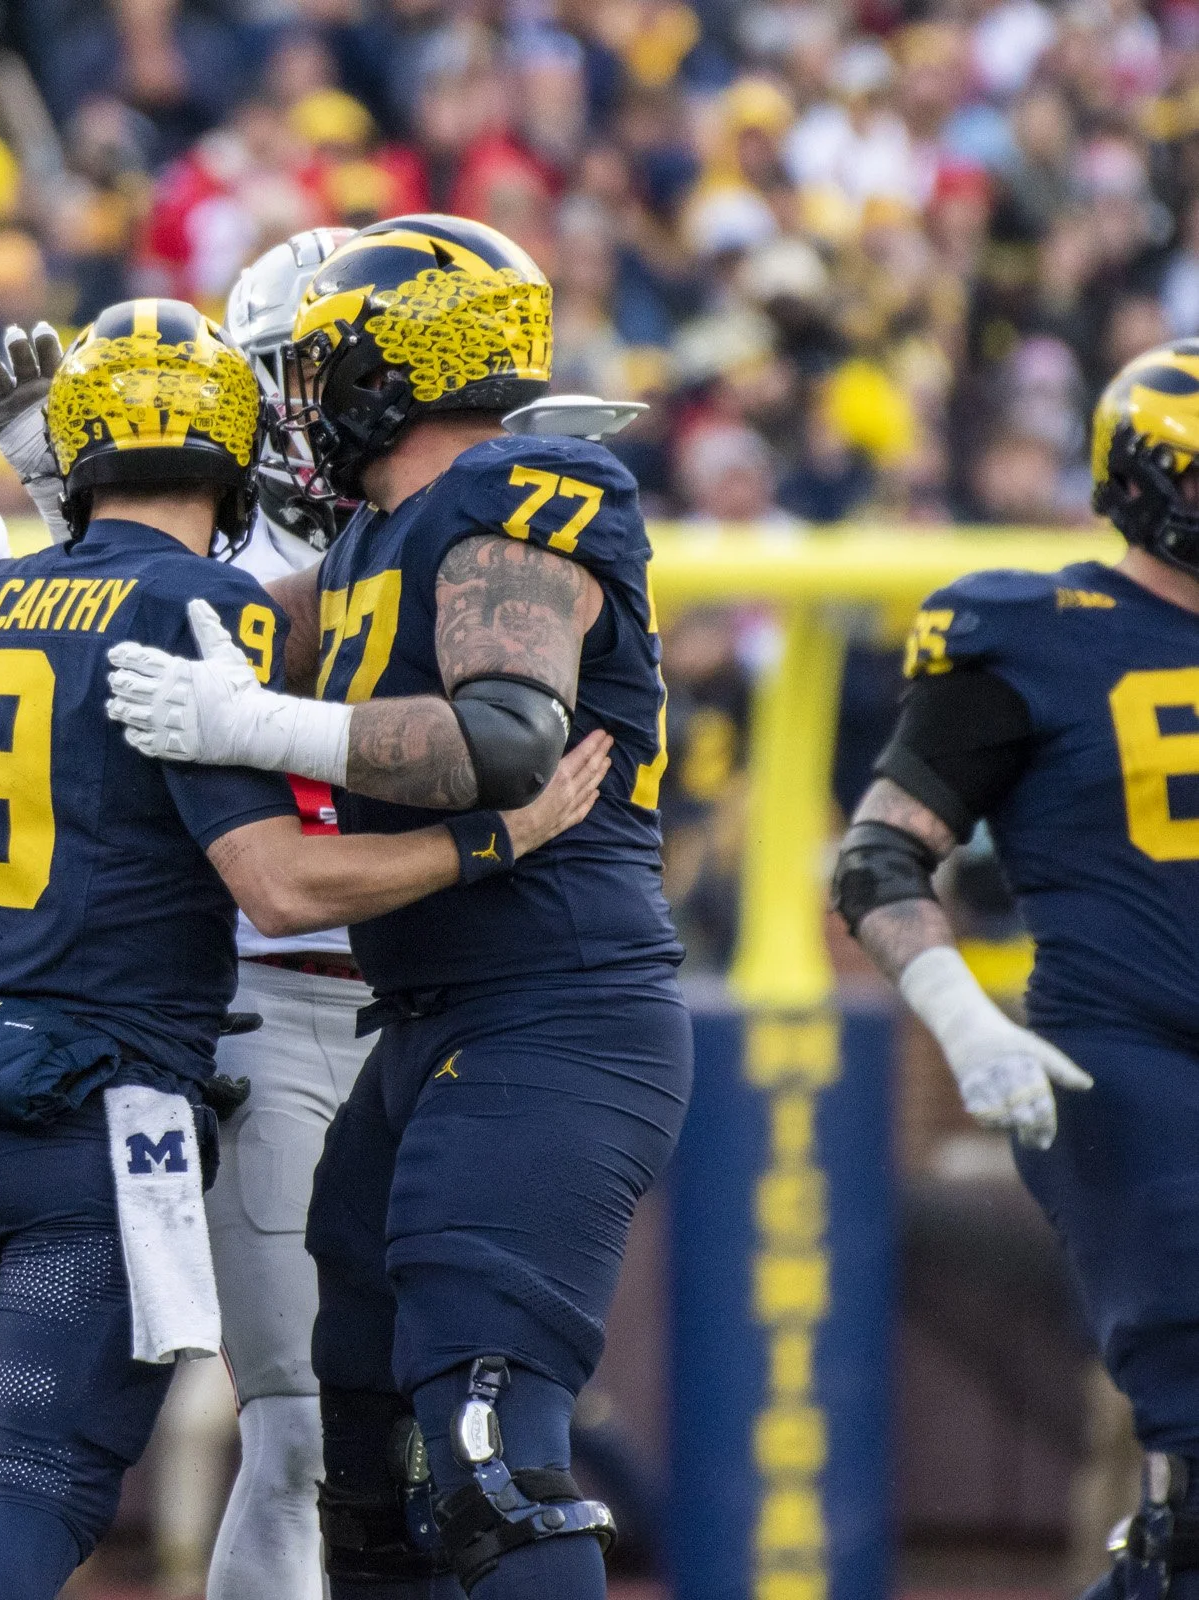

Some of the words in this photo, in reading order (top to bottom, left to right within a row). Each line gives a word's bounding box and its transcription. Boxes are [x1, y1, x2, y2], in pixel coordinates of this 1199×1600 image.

[492, 356, 512, 374] 77
[93, 423, 102, 440] 9
[502, 464, 604, 553] 77
[240, 603, 276, 684] 9
[125, 1130, 188, 1174] M
